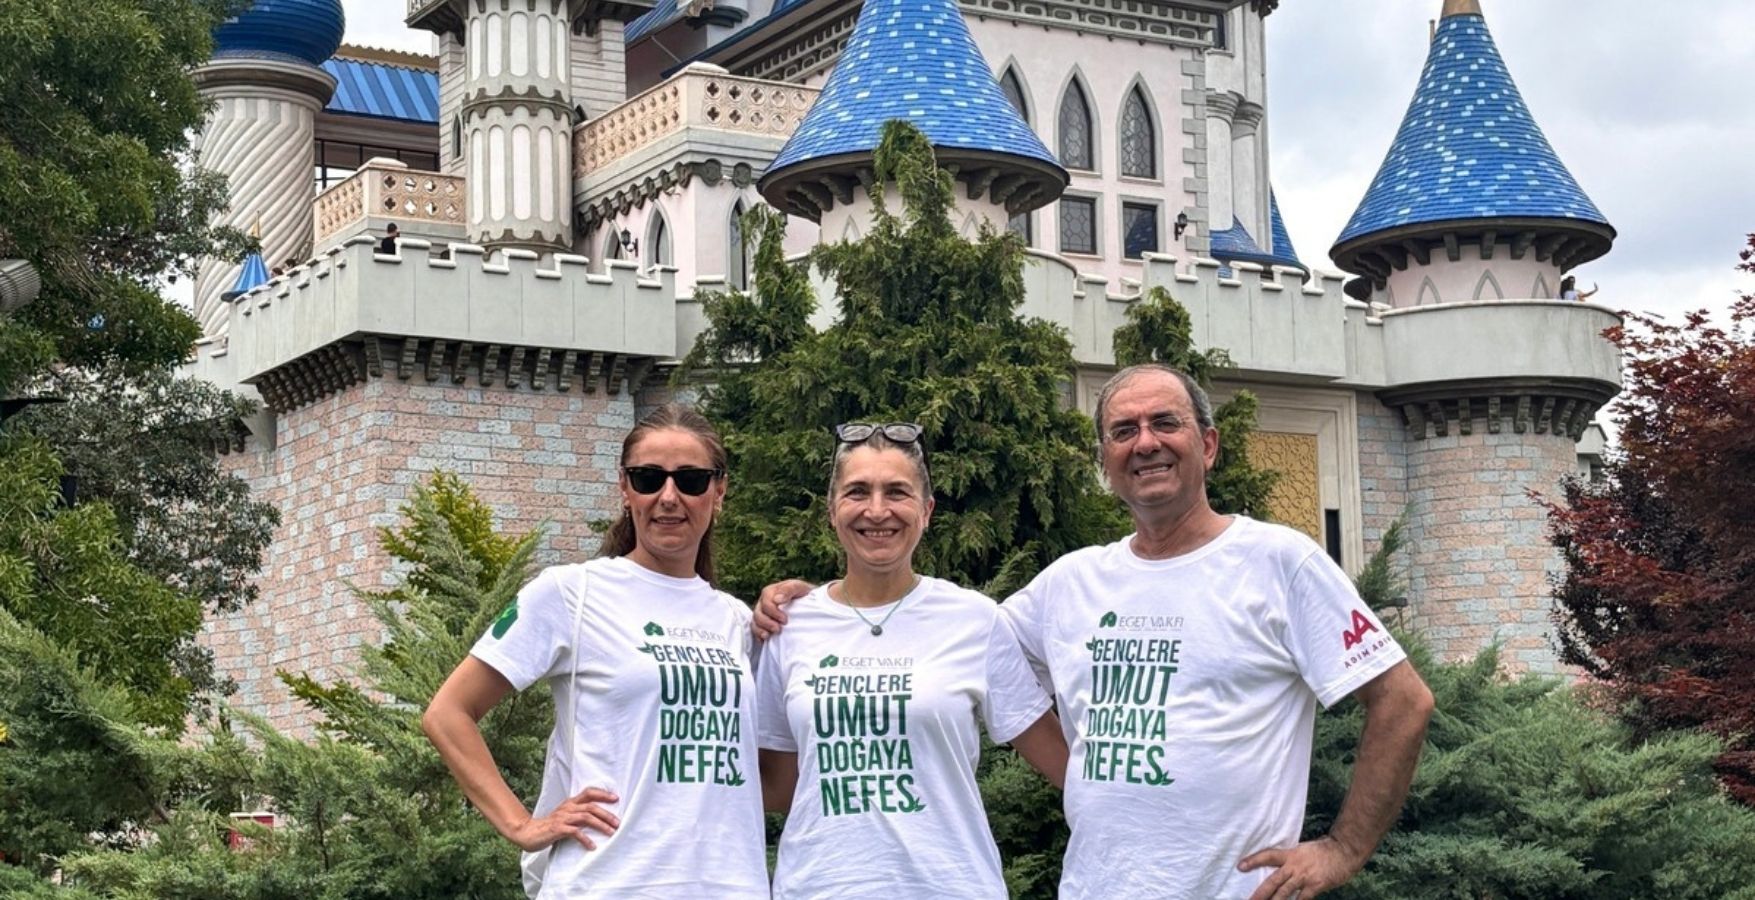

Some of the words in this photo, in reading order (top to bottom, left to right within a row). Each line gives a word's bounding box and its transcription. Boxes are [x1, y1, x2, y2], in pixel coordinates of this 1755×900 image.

[1119, 615, 1148, 628] EGET
[1150, 615, 1184, 629] VAKFI
[842, 656, 875, 667] EGET
[876, 656, 913, 667] VAKFI
[1092, 639, 1182, 666] GENÇLERE
[659, 664, 743, 708] UMUT
[814, 673, 912, 697] GENÇLERE
[1091, 664, 1178, 706] UMUT
[660, 706, 740, 743] DOĞAYA
[813, 694, 912, 739] UMUT
[1086, 705, 1166, 741] DOĞAYA
[656, 744, 741, 787] NEFES
[817, 737, 913, 774] DOĞAYA
[1082, 741, 1166, 787] NEFES
[820, 774, 915, 817] NEFES
